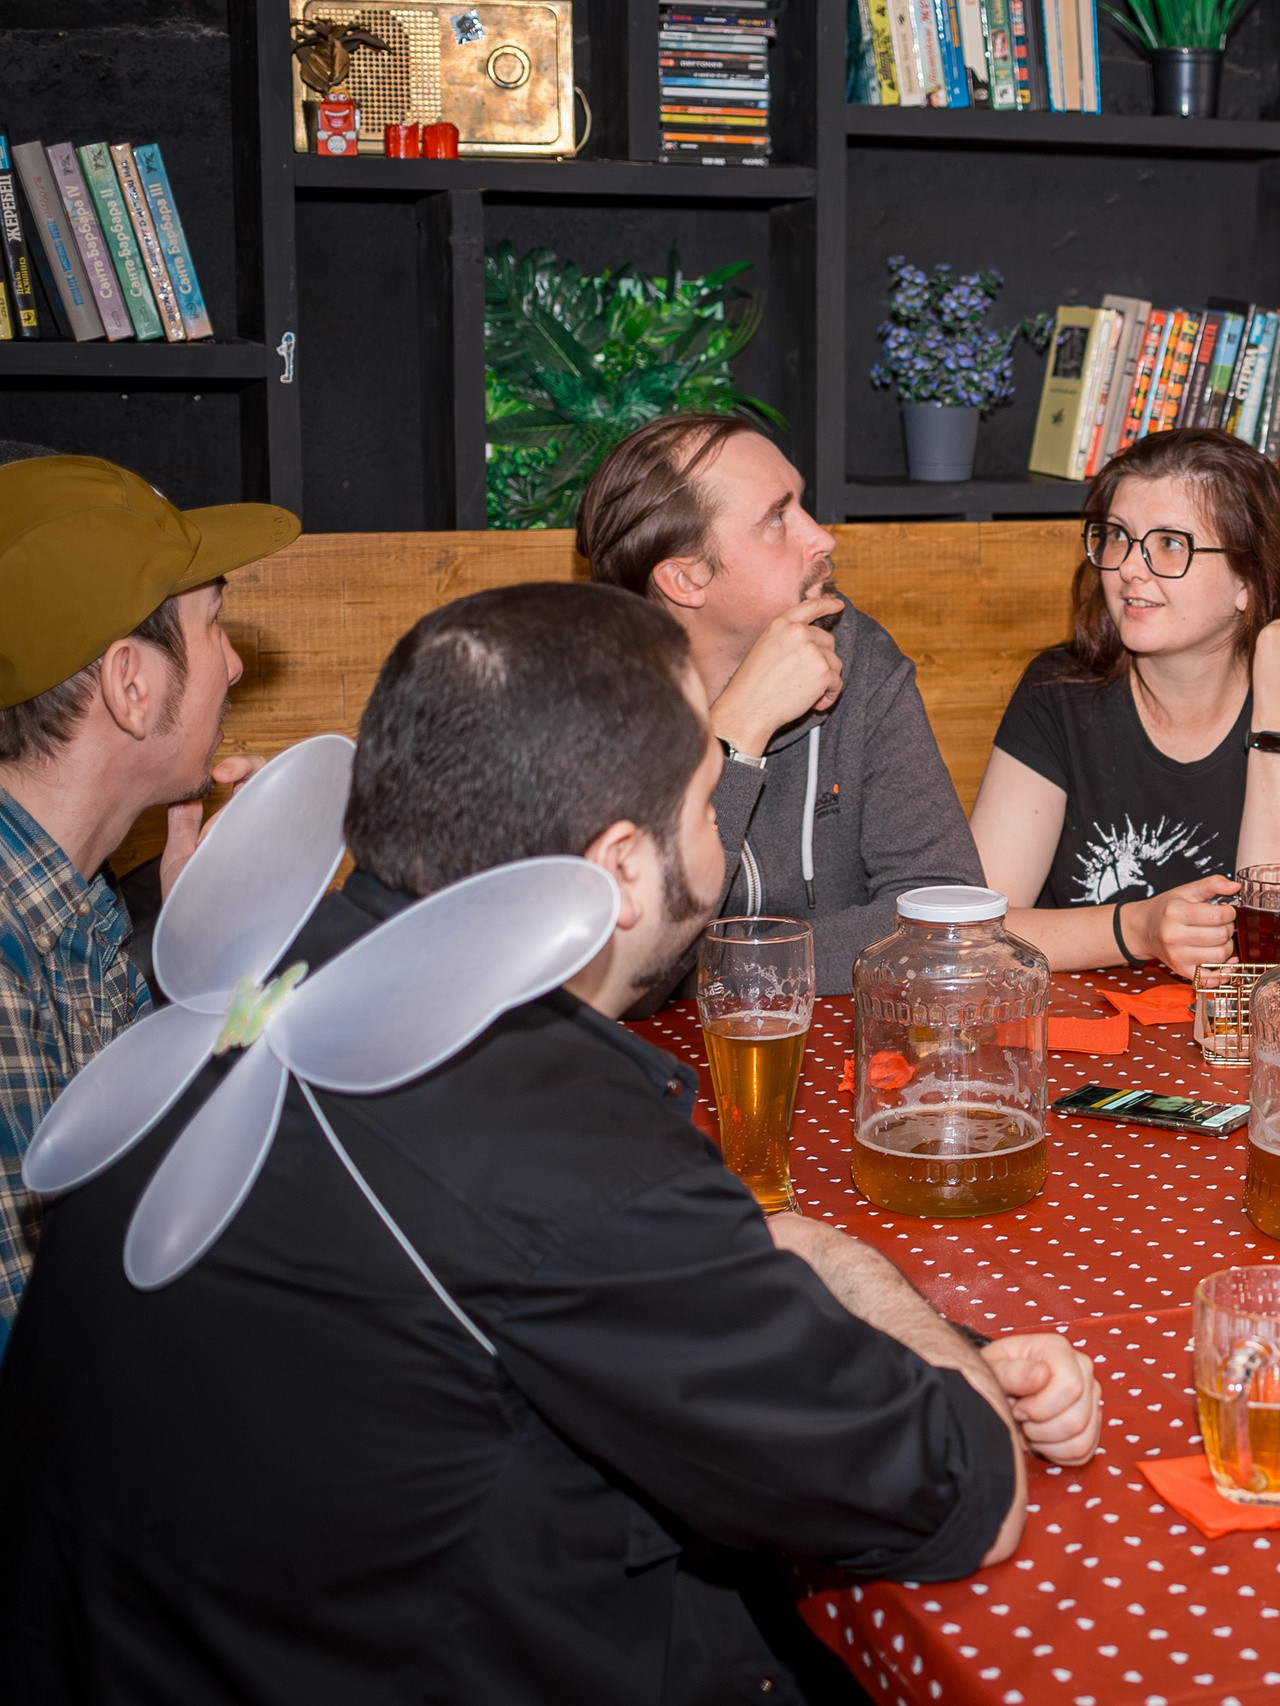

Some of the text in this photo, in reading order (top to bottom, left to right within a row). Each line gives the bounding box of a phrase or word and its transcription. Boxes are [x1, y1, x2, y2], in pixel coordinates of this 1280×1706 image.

[0, 174, 22, 242] ЖЕРЕБЕЦ
[65, 185, 113, 299] Санта-Барбара IV
[107, 200, 142, 297] Санта-Барбара
[149, 183, 192, 295] Санта Барбара III
